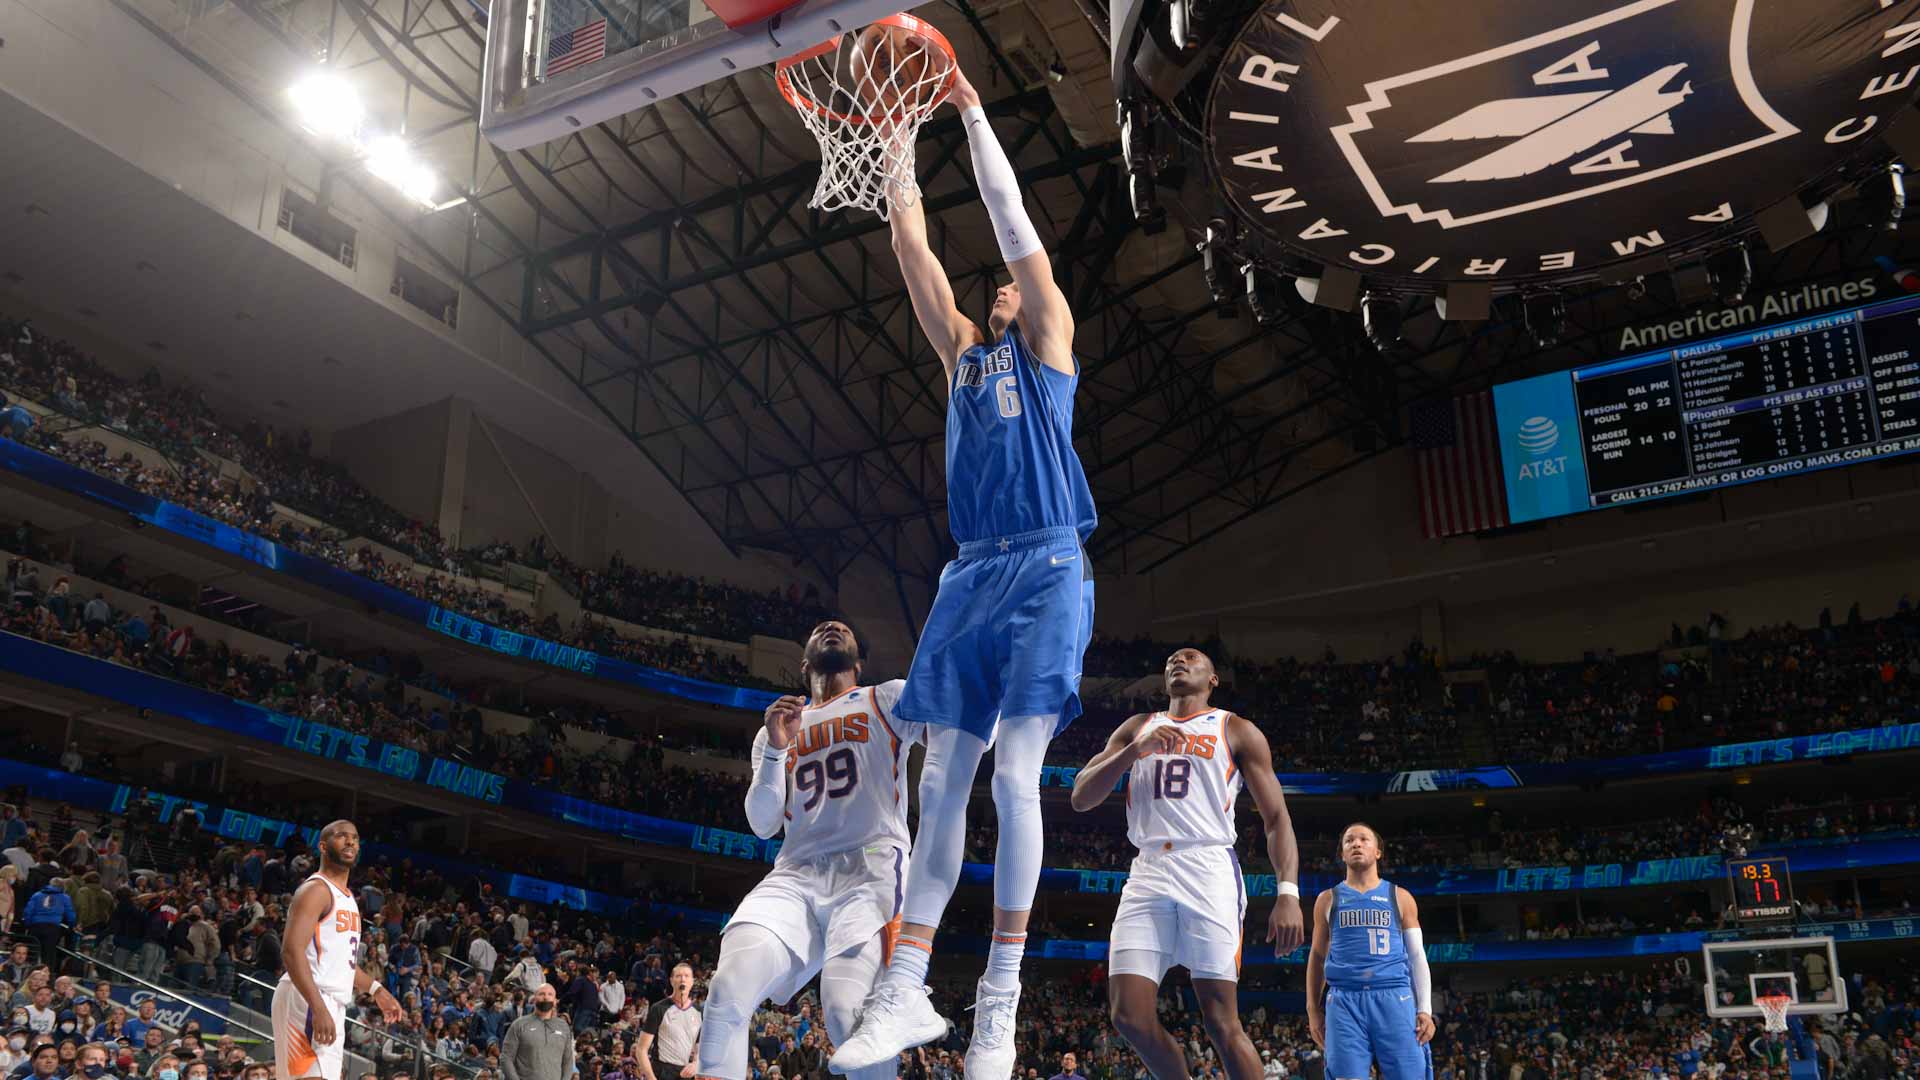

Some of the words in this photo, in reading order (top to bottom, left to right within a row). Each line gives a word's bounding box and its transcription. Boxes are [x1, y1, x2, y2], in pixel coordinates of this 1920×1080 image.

[1251, 186, 1734, 277] AMERICAN
[1619, 302, 1756, 351] American
[1760, 276, 1877, 320] Airlines
[1680, 342, 1722, 358] DALLAS
[1753, 332, 1770, 342] PTS
[1773, 328, 1792, 338] REB
[1794, 324, 1812, 334] AST
[1816, 320, 1832, 328] STL
[1835, 314, 1852, 324] FLS
[1872, 350, 1909, 364] ASSISTS
[1874, 368, 1892, 378] OFF
[995, 376, 1022, 418] 6
[1627, 385, 1647, 396] DAL
[1650, 380, 1670, 391] PHX
[1876, 381, 1894, 392] DEF
[1584, 402, 1628, 416] PERSONAL
[1634, 402, 1648, 412] 20
[1656, 396, 1671, 407] 22
[1689, 404, 1736, 422] Phoenix
[1764, 397, 1782, 408] PTS
[1784, 392, 1802, 403] REB
[1806, 388, 1824, 398] AST
[1828, 384, 1845, 394] STL
[1847, 380, 1865, 390] FLS
[1594, 414, 1621, 424] FOULS
[1881, 409, 1896, 418] TO
[1883, 418, 1917, 432] STEALS
[1592, 428, 1628, 442] LARGEST
[1640, 435, 1654, 445] 14
[1662, 431, 1676, 440] 10
[1592, 438, 1632, 452] SCORING
[1603, 450, 1622, 460] RUN
[1518, 456, 1567, 480] AT&T
[1611, 490, 1637, 502] CALL
[1638, 475, 1718, 497] 214-747-MAVS
[1721, 471, 1738, 483] OR
[1741, 467, 1766, 480] LOG
[1768, 460, 1804, 474] ONTO
[1807, 447, 1874, 468] MAVS.COM
[1876, 442, 1901, 456] FOR
[426, 606, 484, 644] LET'S
[530, 638, 600, 674] MAVS
[284, 715, 370, 767] LET'S
[427, 756, 506, 804] MAVS
[1709, 738, 1794, 769] LET'S
[795, 746, 858, 812] 99
[1154, 759, 1192, 800] 18
[691, 824, 756, 860] LET'S
[1497, 866, 1572, 893] LET'S
[1584, 863, 1623, 890] GO
[1743, 864, 1771, 880] 19.3
[1754, 878, 1780, 903] 17
[1338, 909, 1392, 928] DALLAS
[1754, 905, 1792, 916] TISSOT
[1367, 928, 1391, 956] 13
